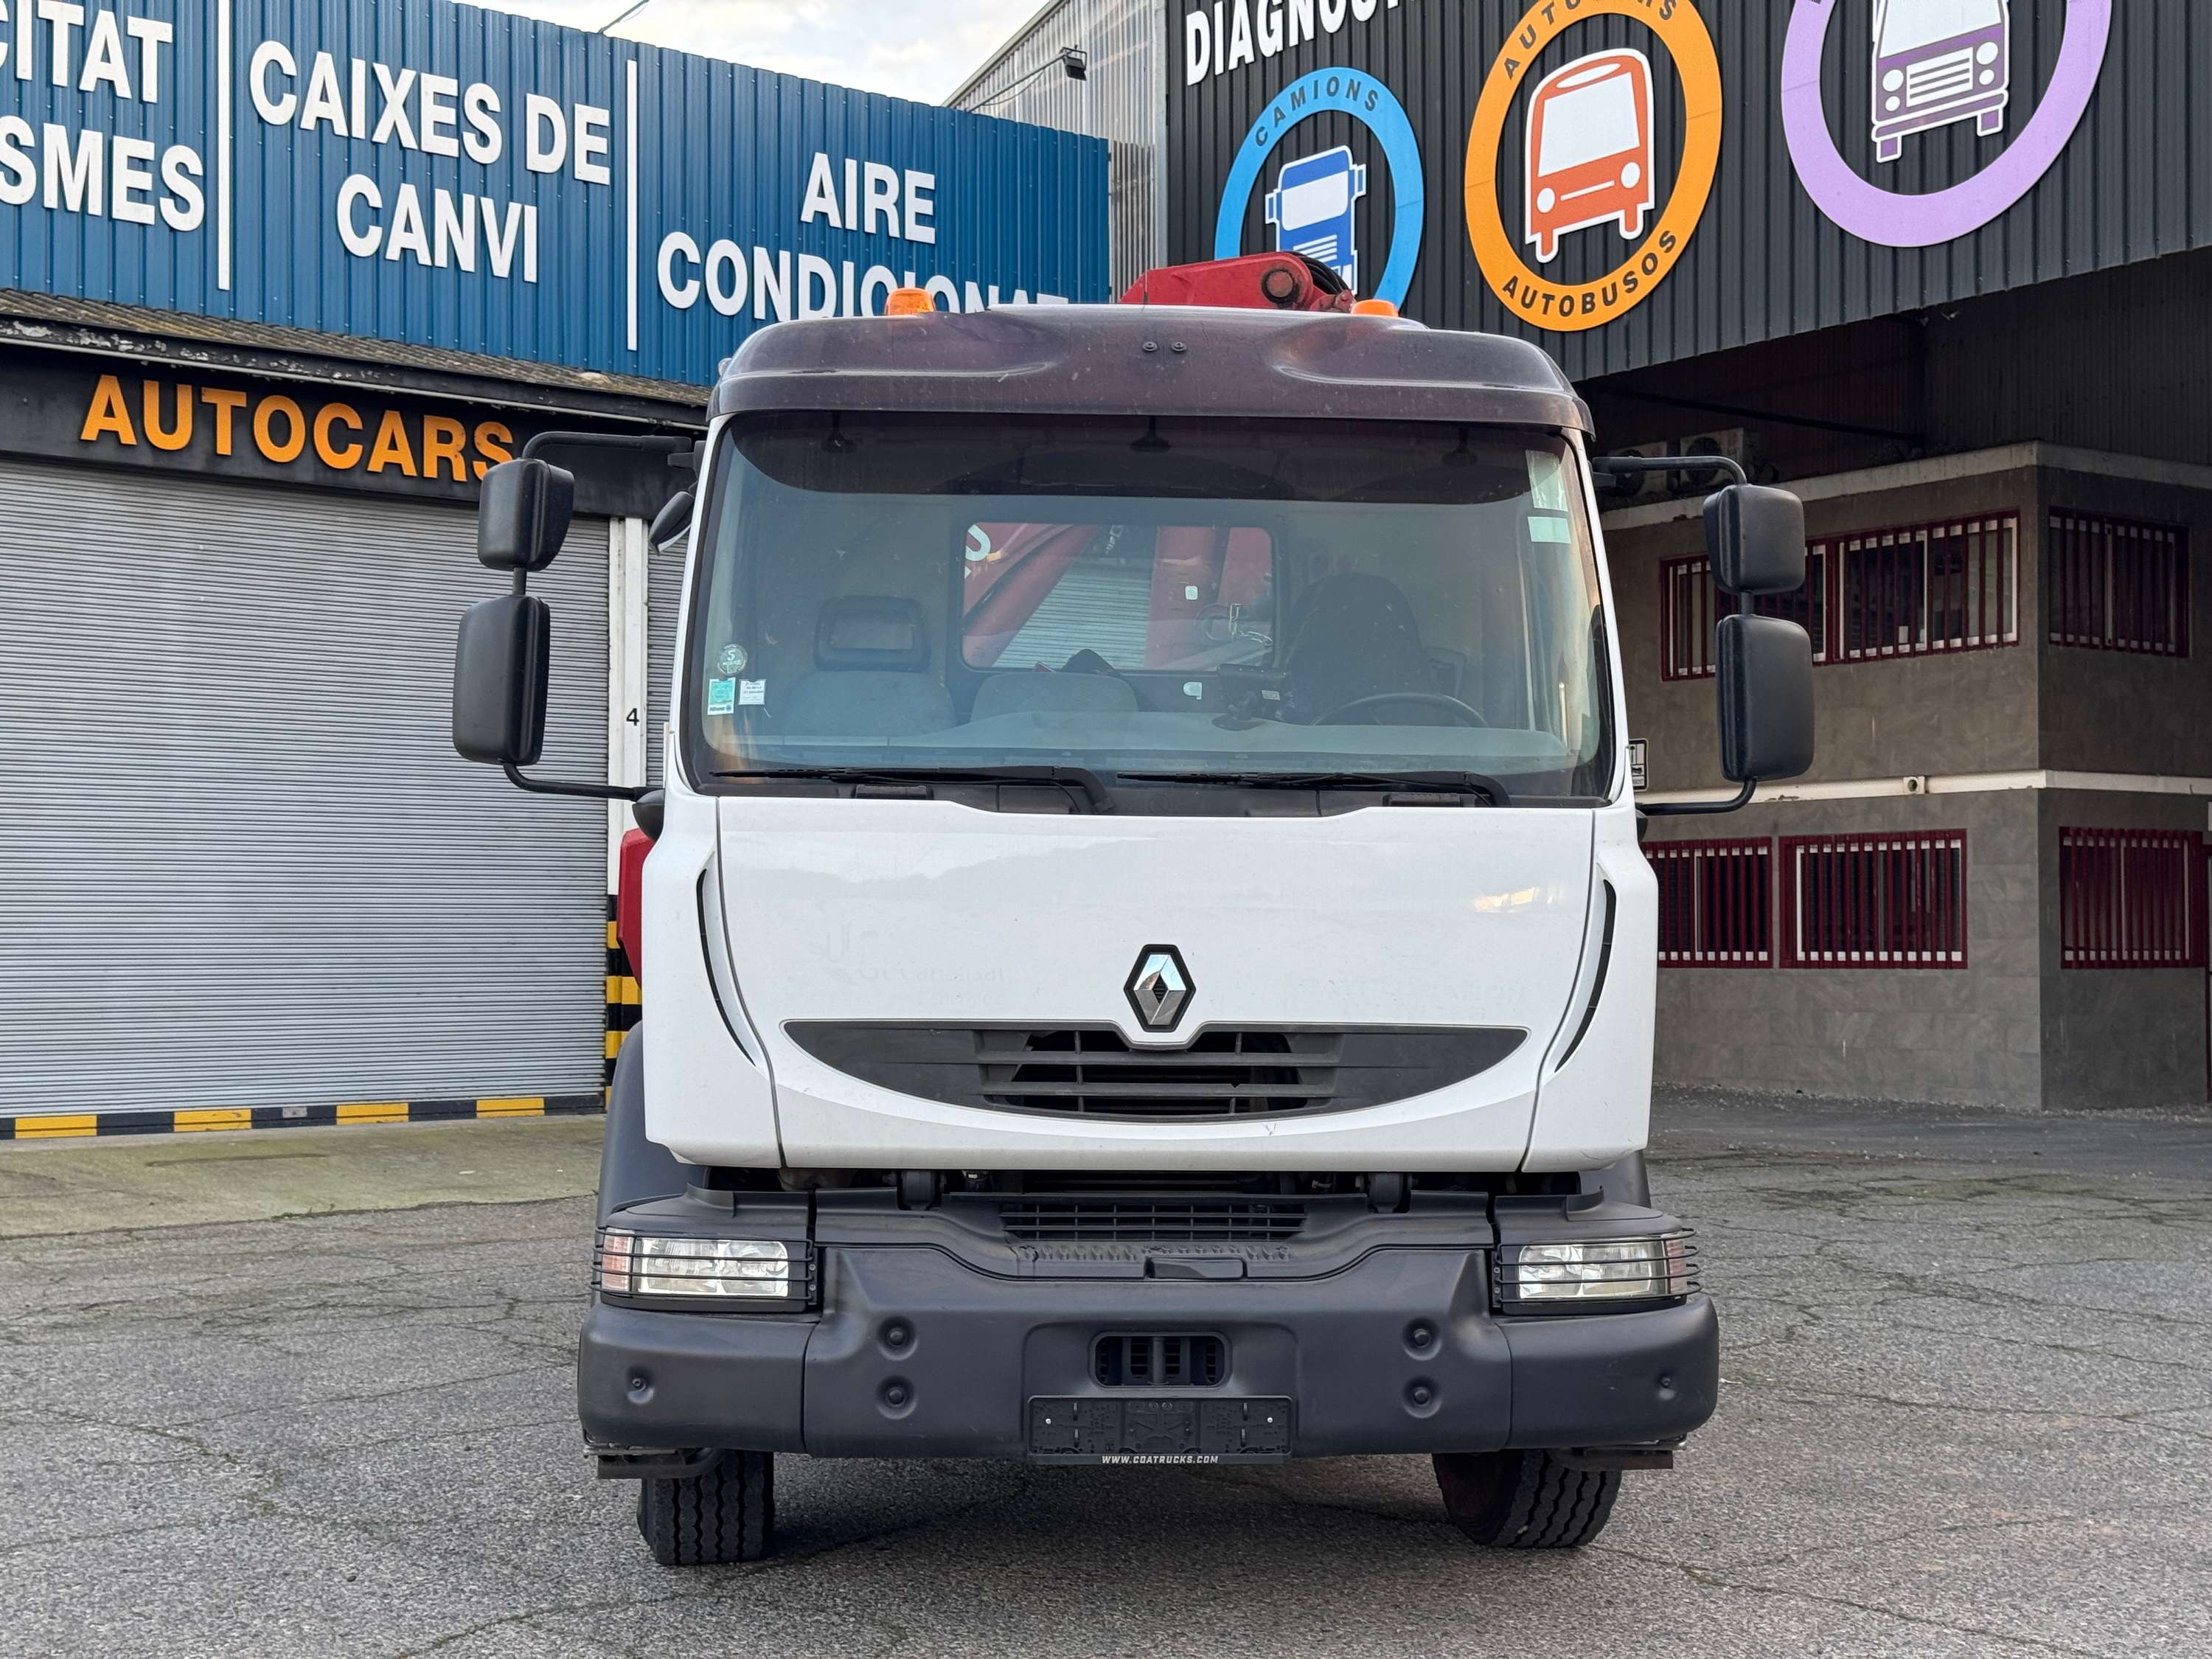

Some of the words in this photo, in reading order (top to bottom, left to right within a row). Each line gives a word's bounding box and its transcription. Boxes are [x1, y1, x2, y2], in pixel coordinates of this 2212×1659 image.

[0, 0, 173, 103] ITAT
[250, 41, 503, 164] CAIXES
[526, 93, 611, 186] DE
[1255, 76, 1379, 147] CAMIONS
[337, 174, 538, 283] CANVI
[801, 153, 936, 244] AIRE
[1502, 230, 1677, 318] AUTOBUSOS
[80, 375, 514, 482] AUTOCARS
[626, 708, 640, 726] 4
